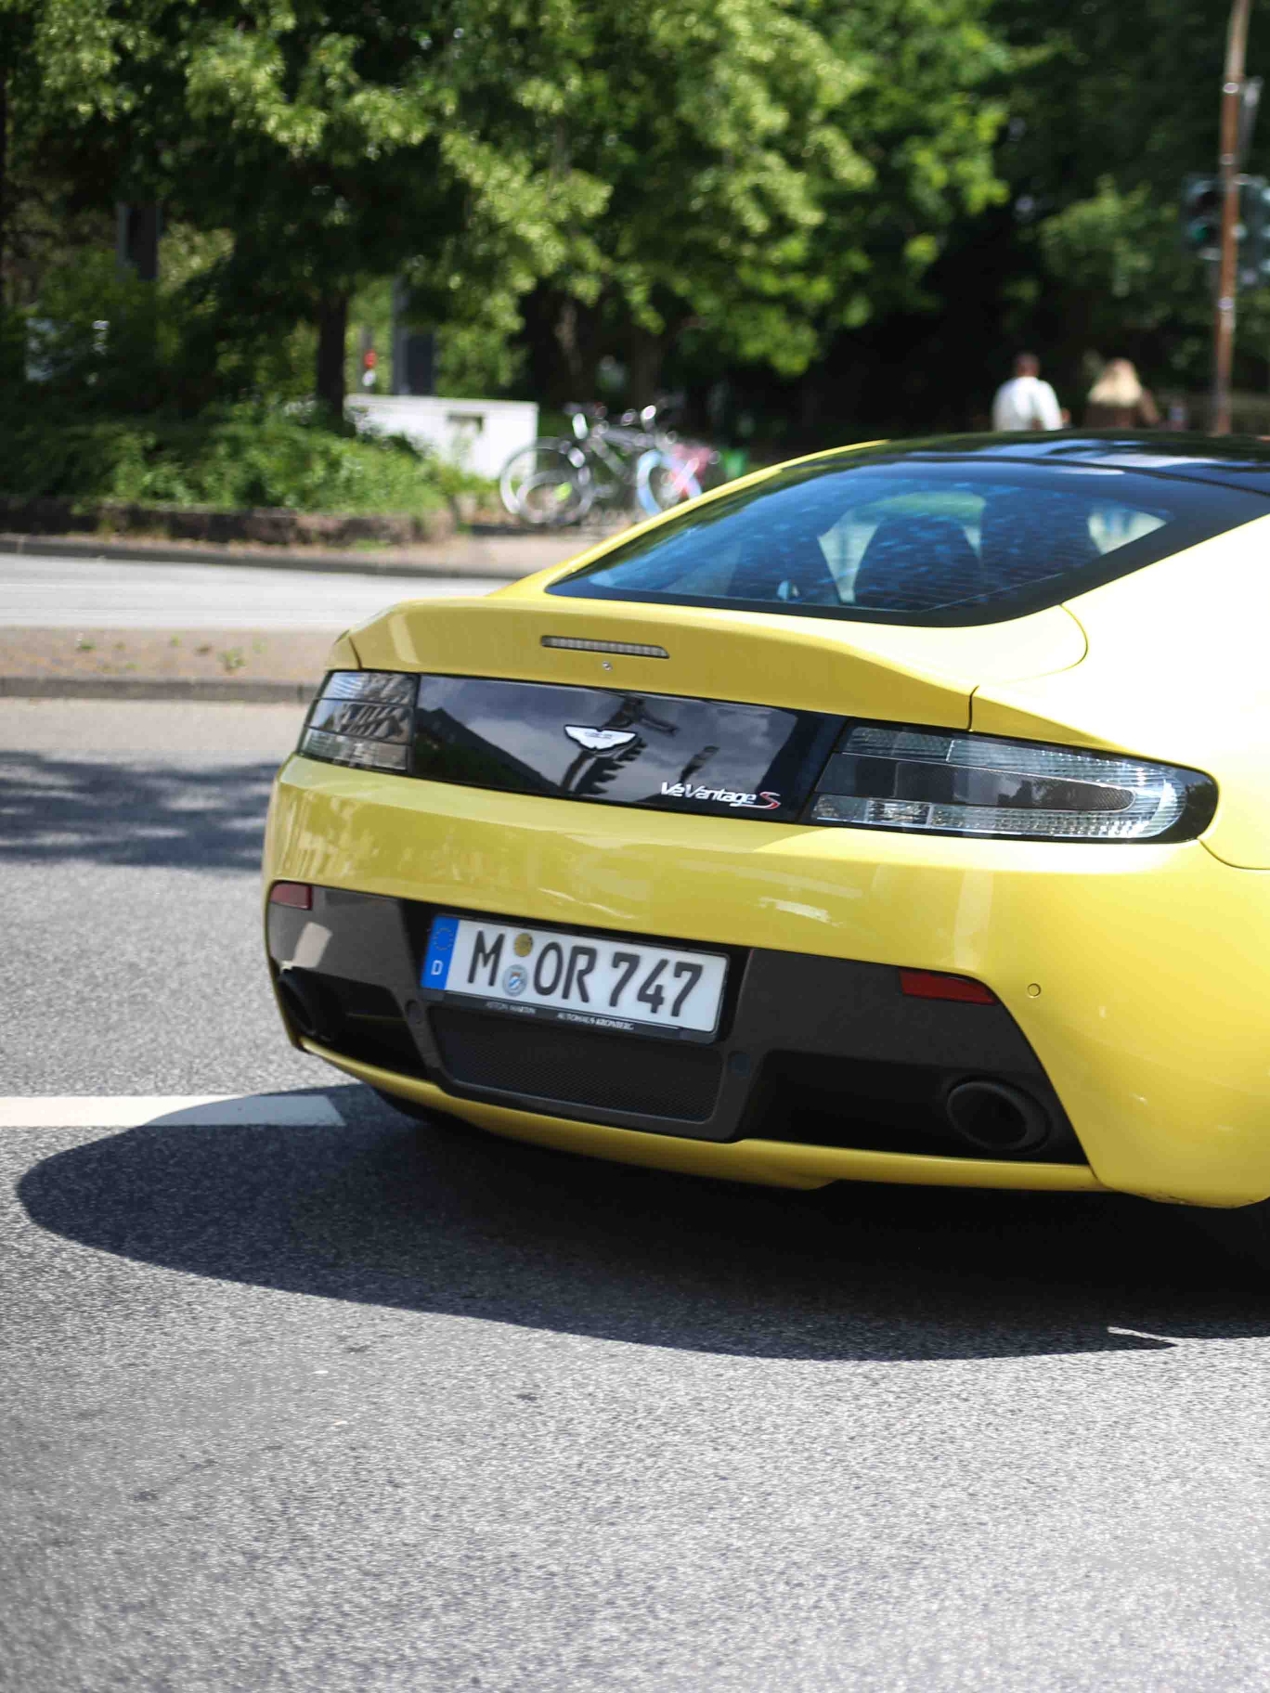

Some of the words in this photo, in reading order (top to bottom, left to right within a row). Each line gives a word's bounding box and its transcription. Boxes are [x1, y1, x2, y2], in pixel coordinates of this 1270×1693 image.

[685, 783, 757, 807] Vantage
[759, 791, 781, 809] S
[430, 959, 443, 976] D
[467, 929, 506, 987] M
[532, 941, 598, 1003] OR
[608, 951, 704, 1018] 747
